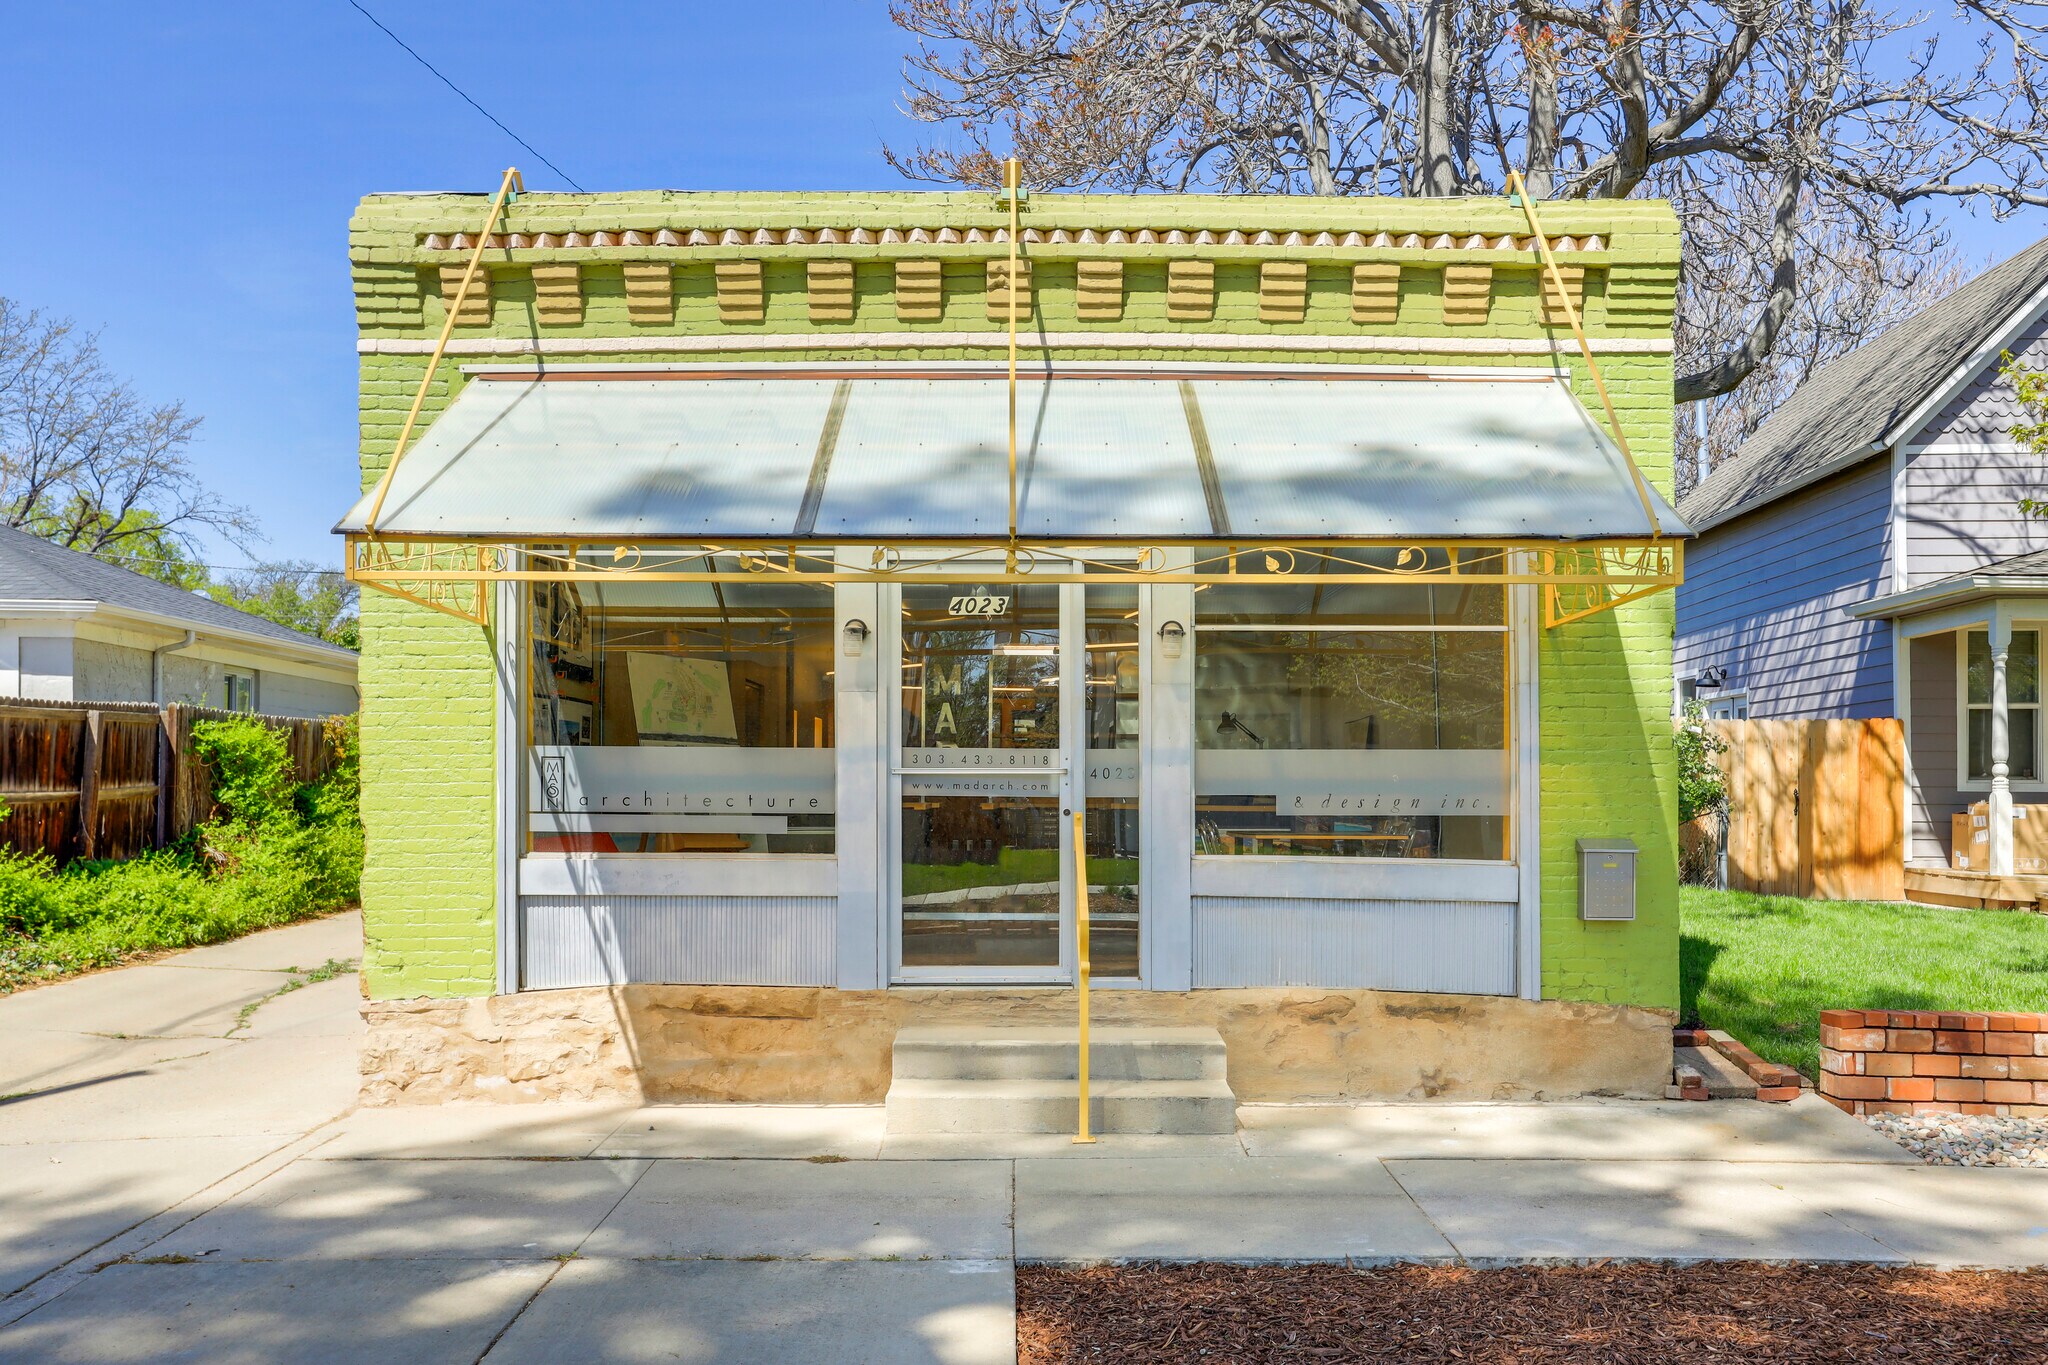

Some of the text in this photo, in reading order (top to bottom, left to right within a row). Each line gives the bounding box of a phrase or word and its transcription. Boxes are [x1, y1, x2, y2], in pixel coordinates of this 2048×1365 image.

[950, 597, 1006, 614] 4023
[912, 754, 1049, 766] 303.433.8118
[1090, 767, 1135, 780] 4023
[912, 780, 1049, 791] www.madarch.com
[579, 791, 818, 808] architecture
[1294, 794, 1492, 813] & design inc.
